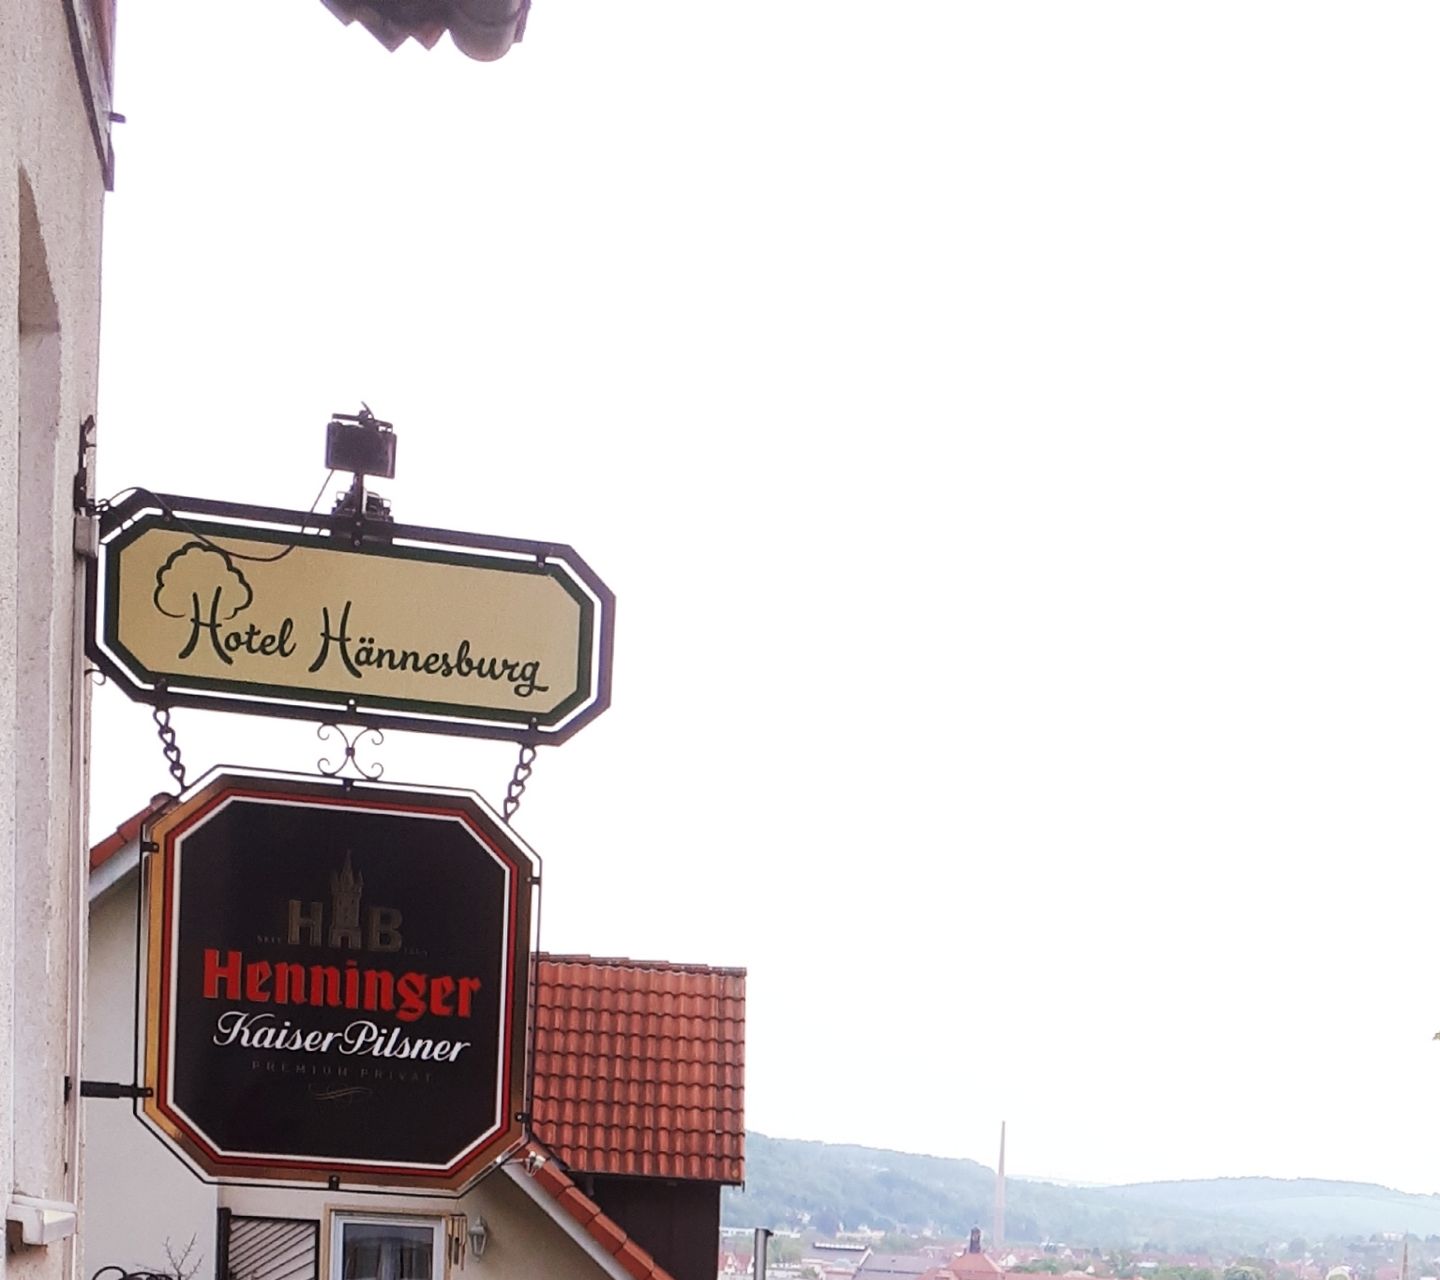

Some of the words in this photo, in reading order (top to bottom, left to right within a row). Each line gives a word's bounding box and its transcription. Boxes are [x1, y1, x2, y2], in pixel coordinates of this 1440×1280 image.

[179, 586, 297, 664] Hotel
[308, 600, 549, 696] Hännesburg
[203, 948, 482, 1020] Henninger
